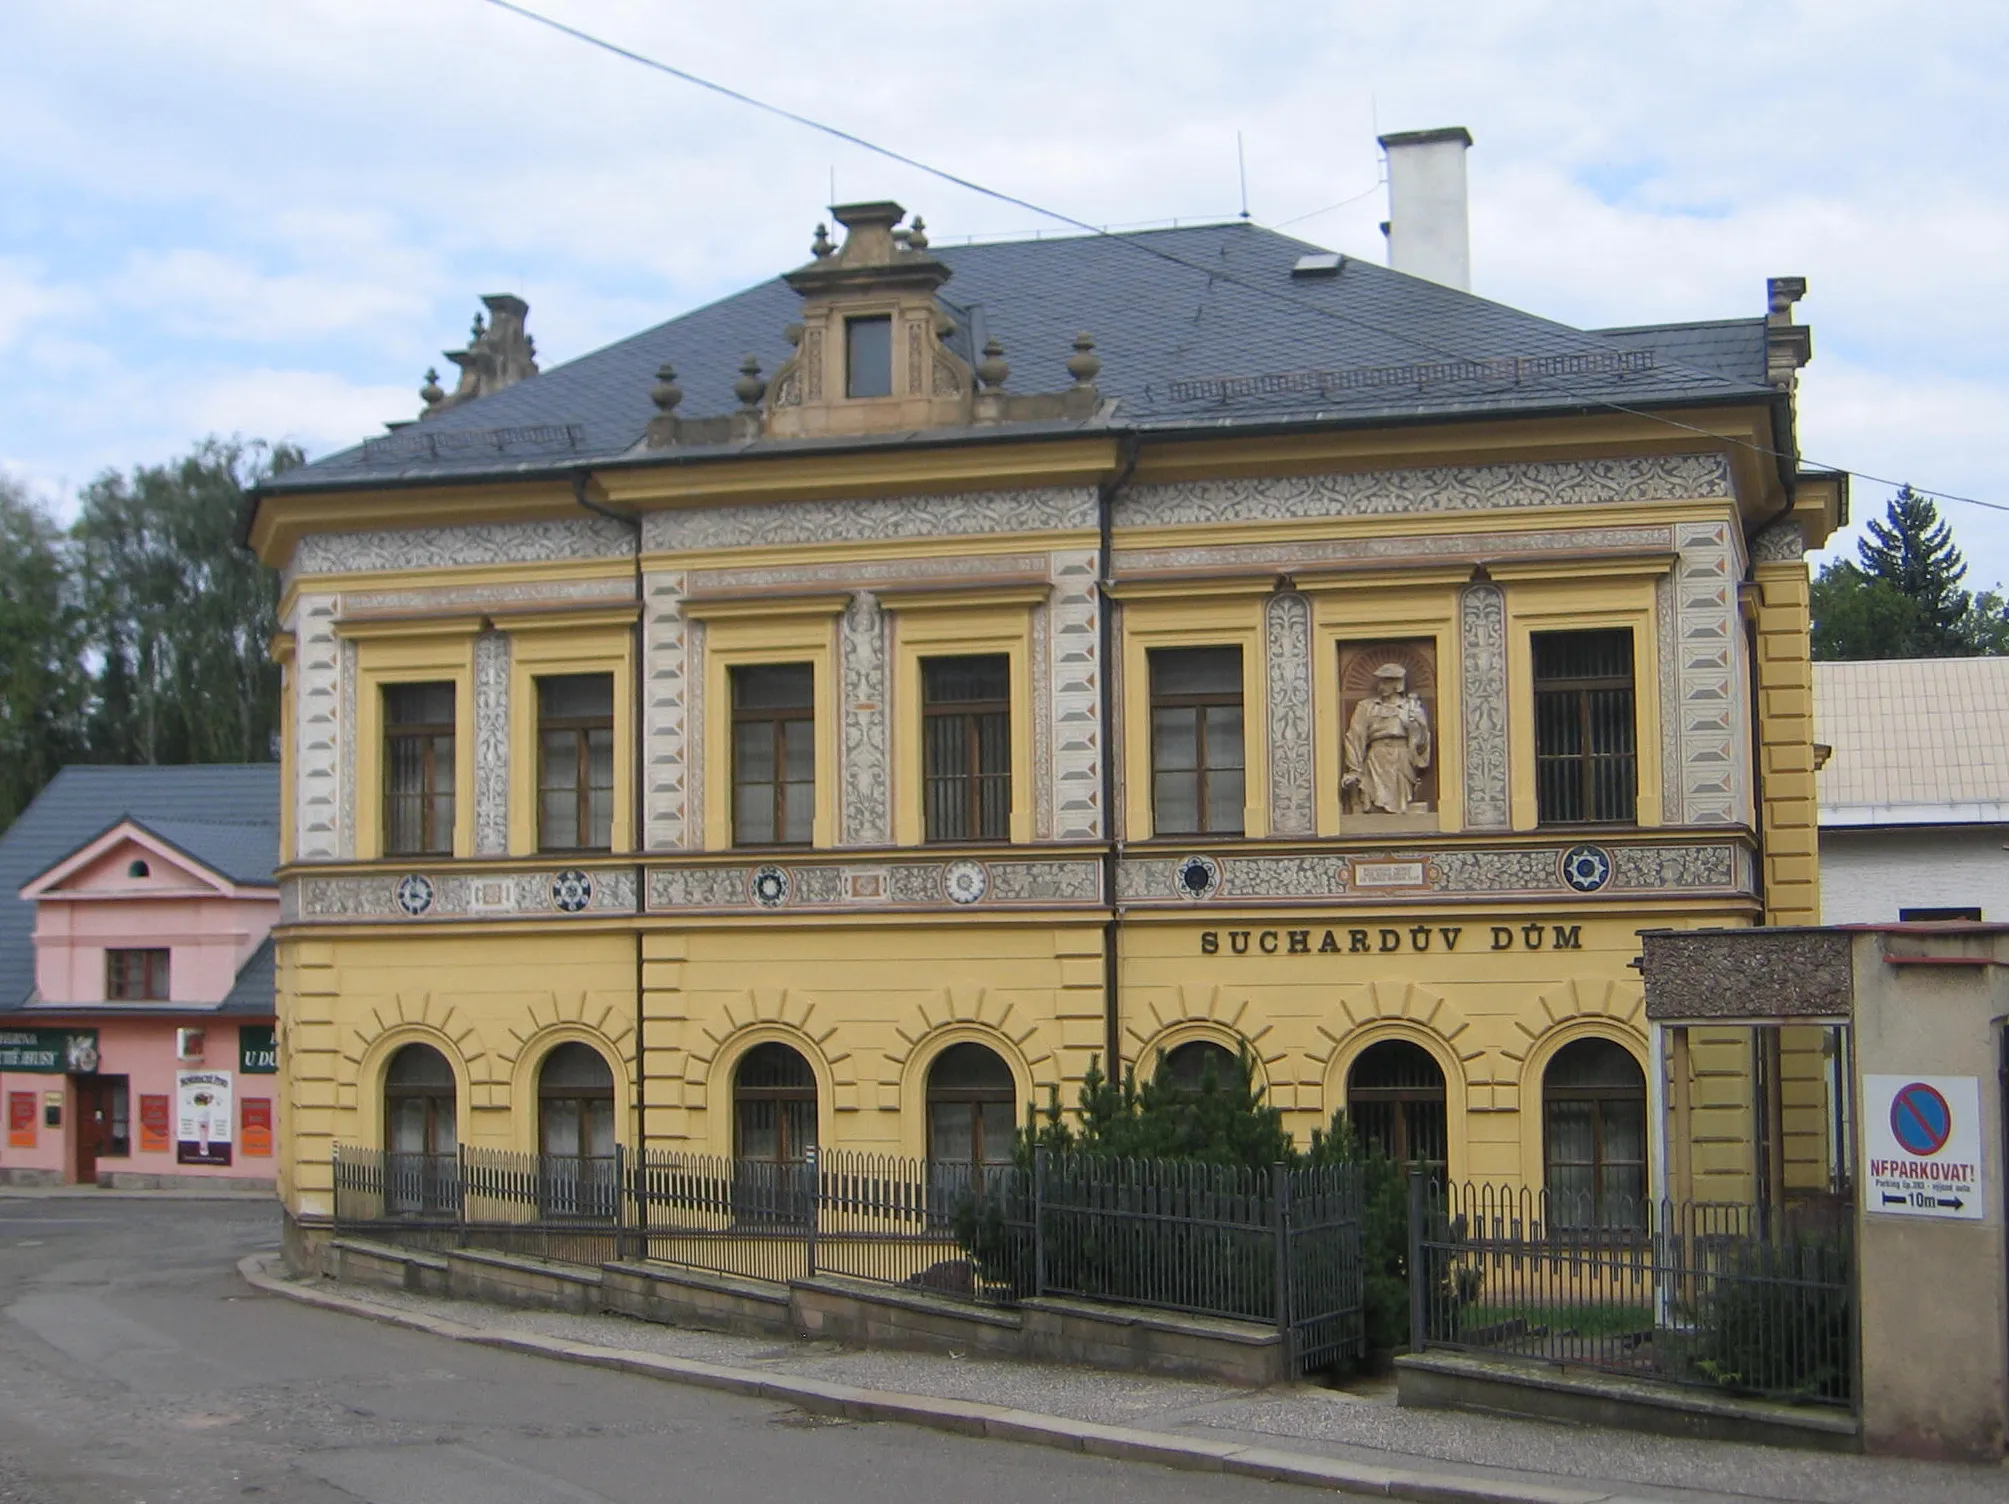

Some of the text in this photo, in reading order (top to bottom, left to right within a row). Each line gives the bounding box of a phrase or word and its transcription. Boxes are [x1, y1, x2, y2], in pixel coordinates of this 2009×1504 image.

[1200, 923, 1581, 953] SUCHARDŮV DŮM
[1908, 1192, 1936, 1208] 10m
